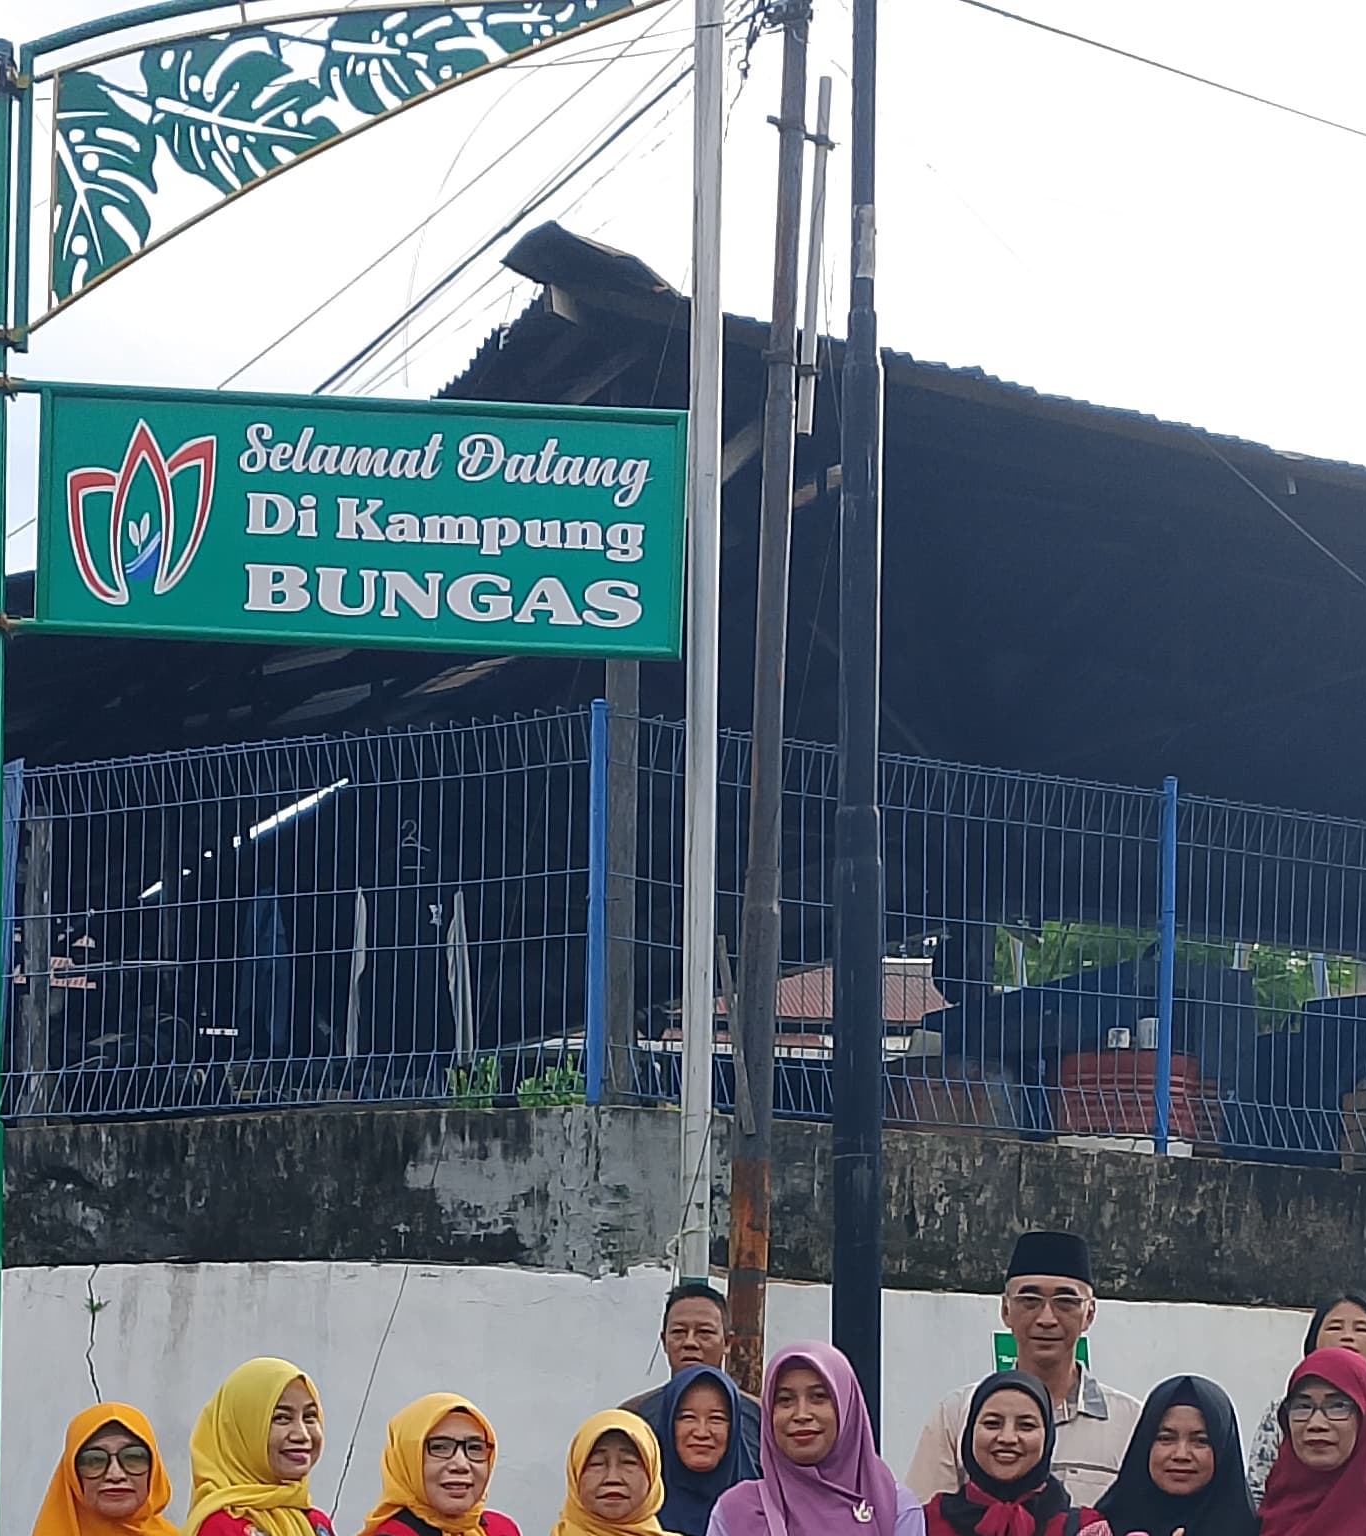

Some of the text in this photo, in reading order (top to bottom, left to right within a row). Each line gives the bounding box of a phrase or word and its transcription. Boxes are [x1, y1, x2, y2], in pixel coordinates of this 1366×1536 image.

[239, 423, 653, 508] Selamat Datang
[246, 492, 645, 562] Di Kampung
[244, 563, 643, 629] BUNGAS
